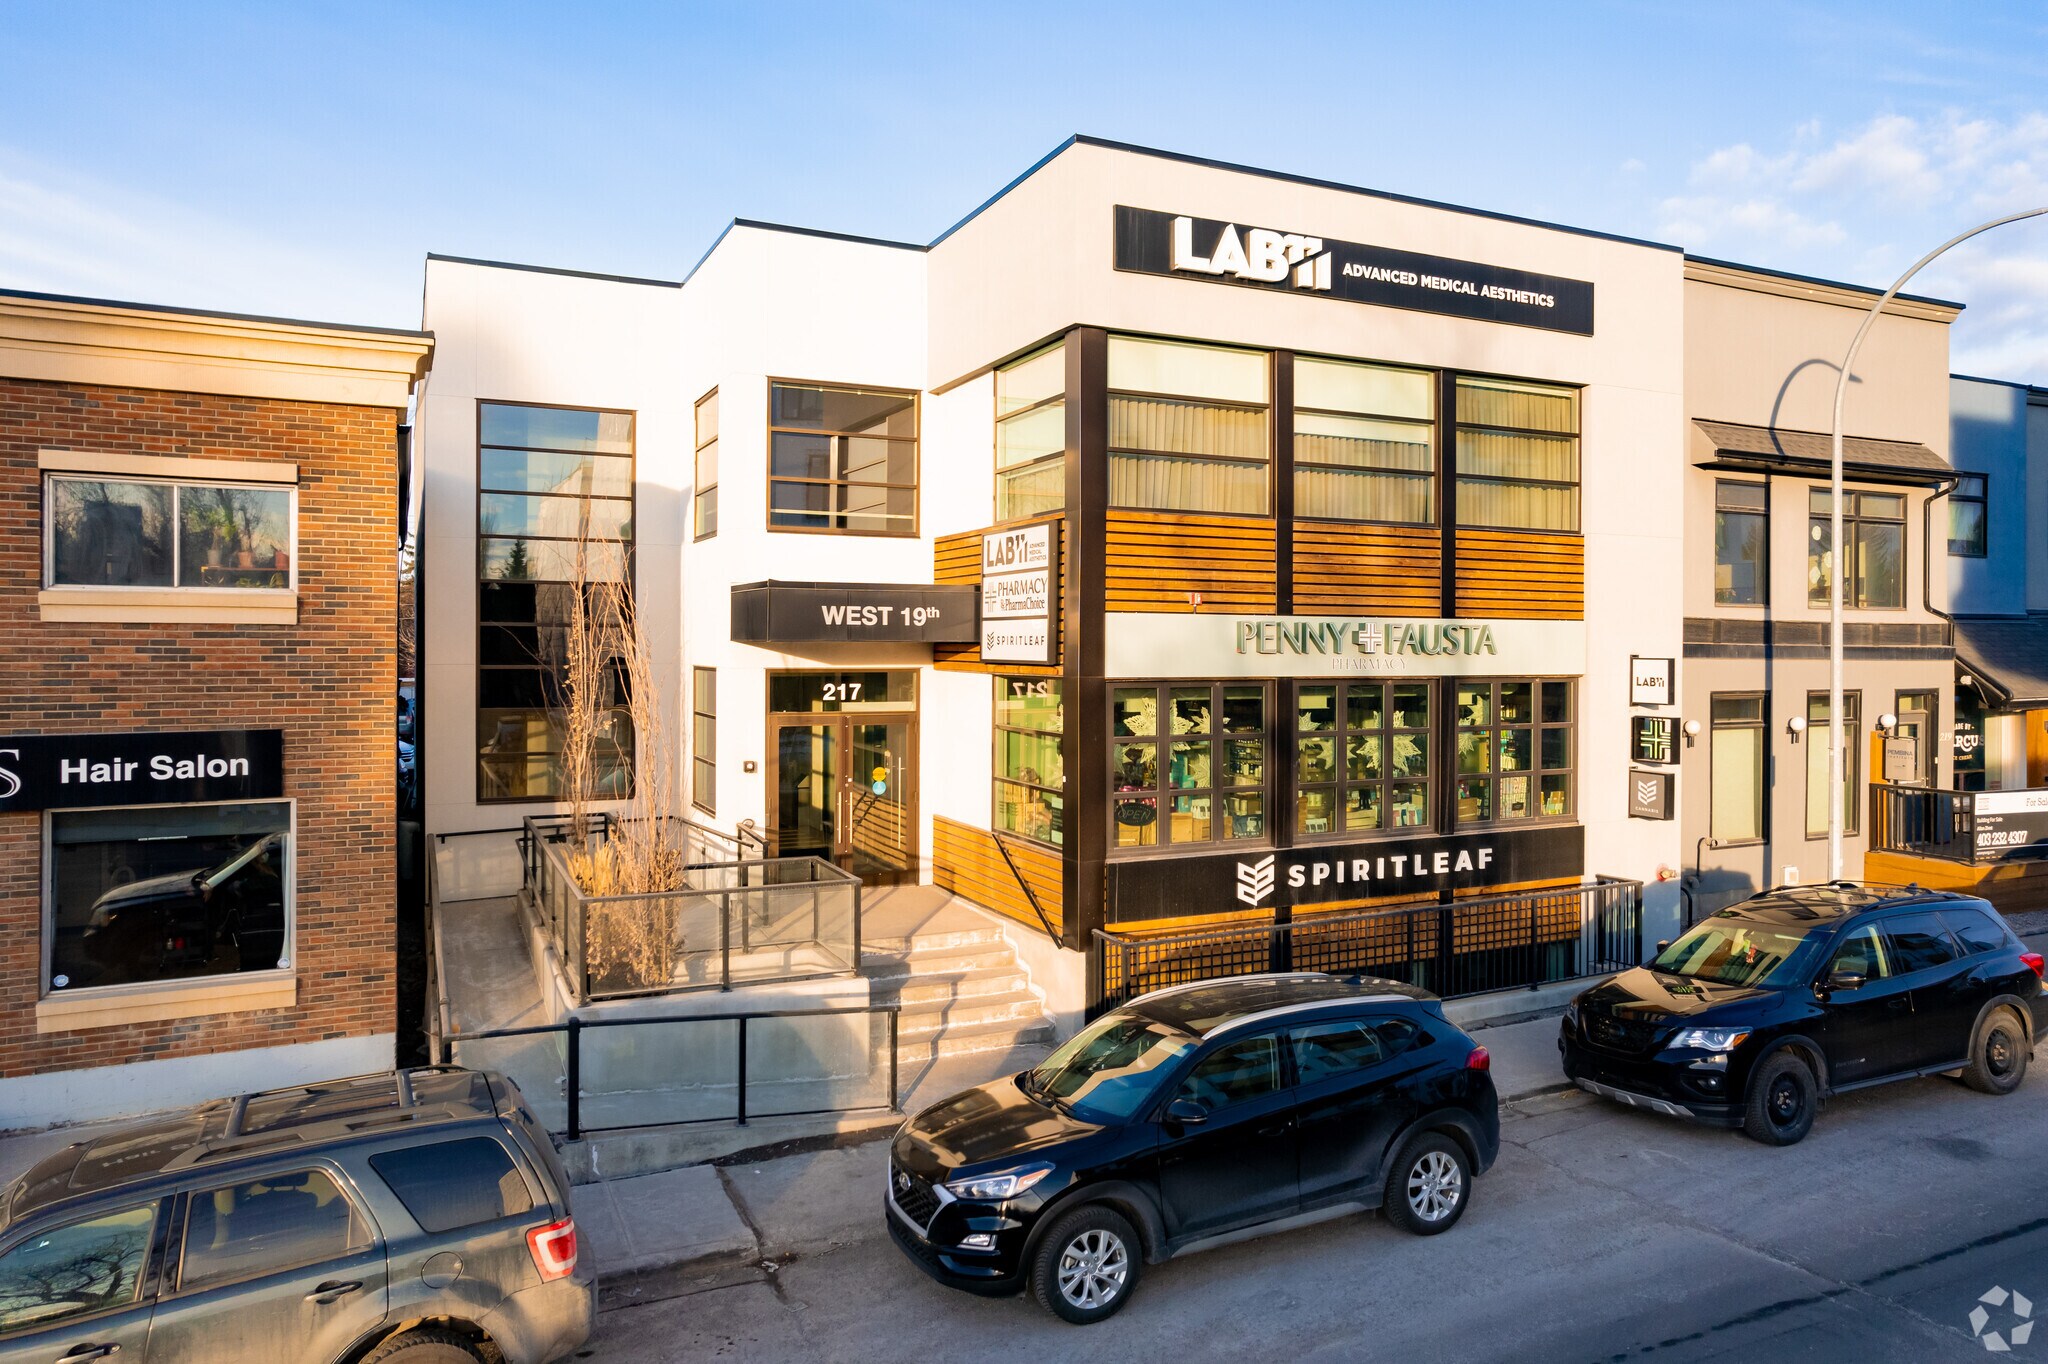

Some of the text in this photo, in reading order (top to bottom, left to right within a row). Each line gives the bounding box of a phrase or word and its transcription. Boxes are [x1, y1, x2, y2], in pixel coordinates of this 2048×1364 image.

[1342, 262, 1555, 308] ADVANCED MEDICAL AESTHETICS
[998, 577, 1048, 598] PHARMACY
[821, 605, 940, 626] WEST 19th
[996, 635, 1045, 646] SPIRITLEAF
[1236, 620, 1498, 655] PENNY FAUSTA
[1331, 657, 1408, 671] PHARMACY
[822, 683, 862, 700] 217
[1940, 732, 1953, 741] 219
[1953, 734, 1984, 752] RCUS
[61, 757, 139, 784] Hair
[150, 754, 249, 781] Salon
[1117, 809, 1152, 820] OPEN
[1976, 830, 2028, 847] 403 232 4307
[1288, 847, 1494, 888] SPIRITLEAF
